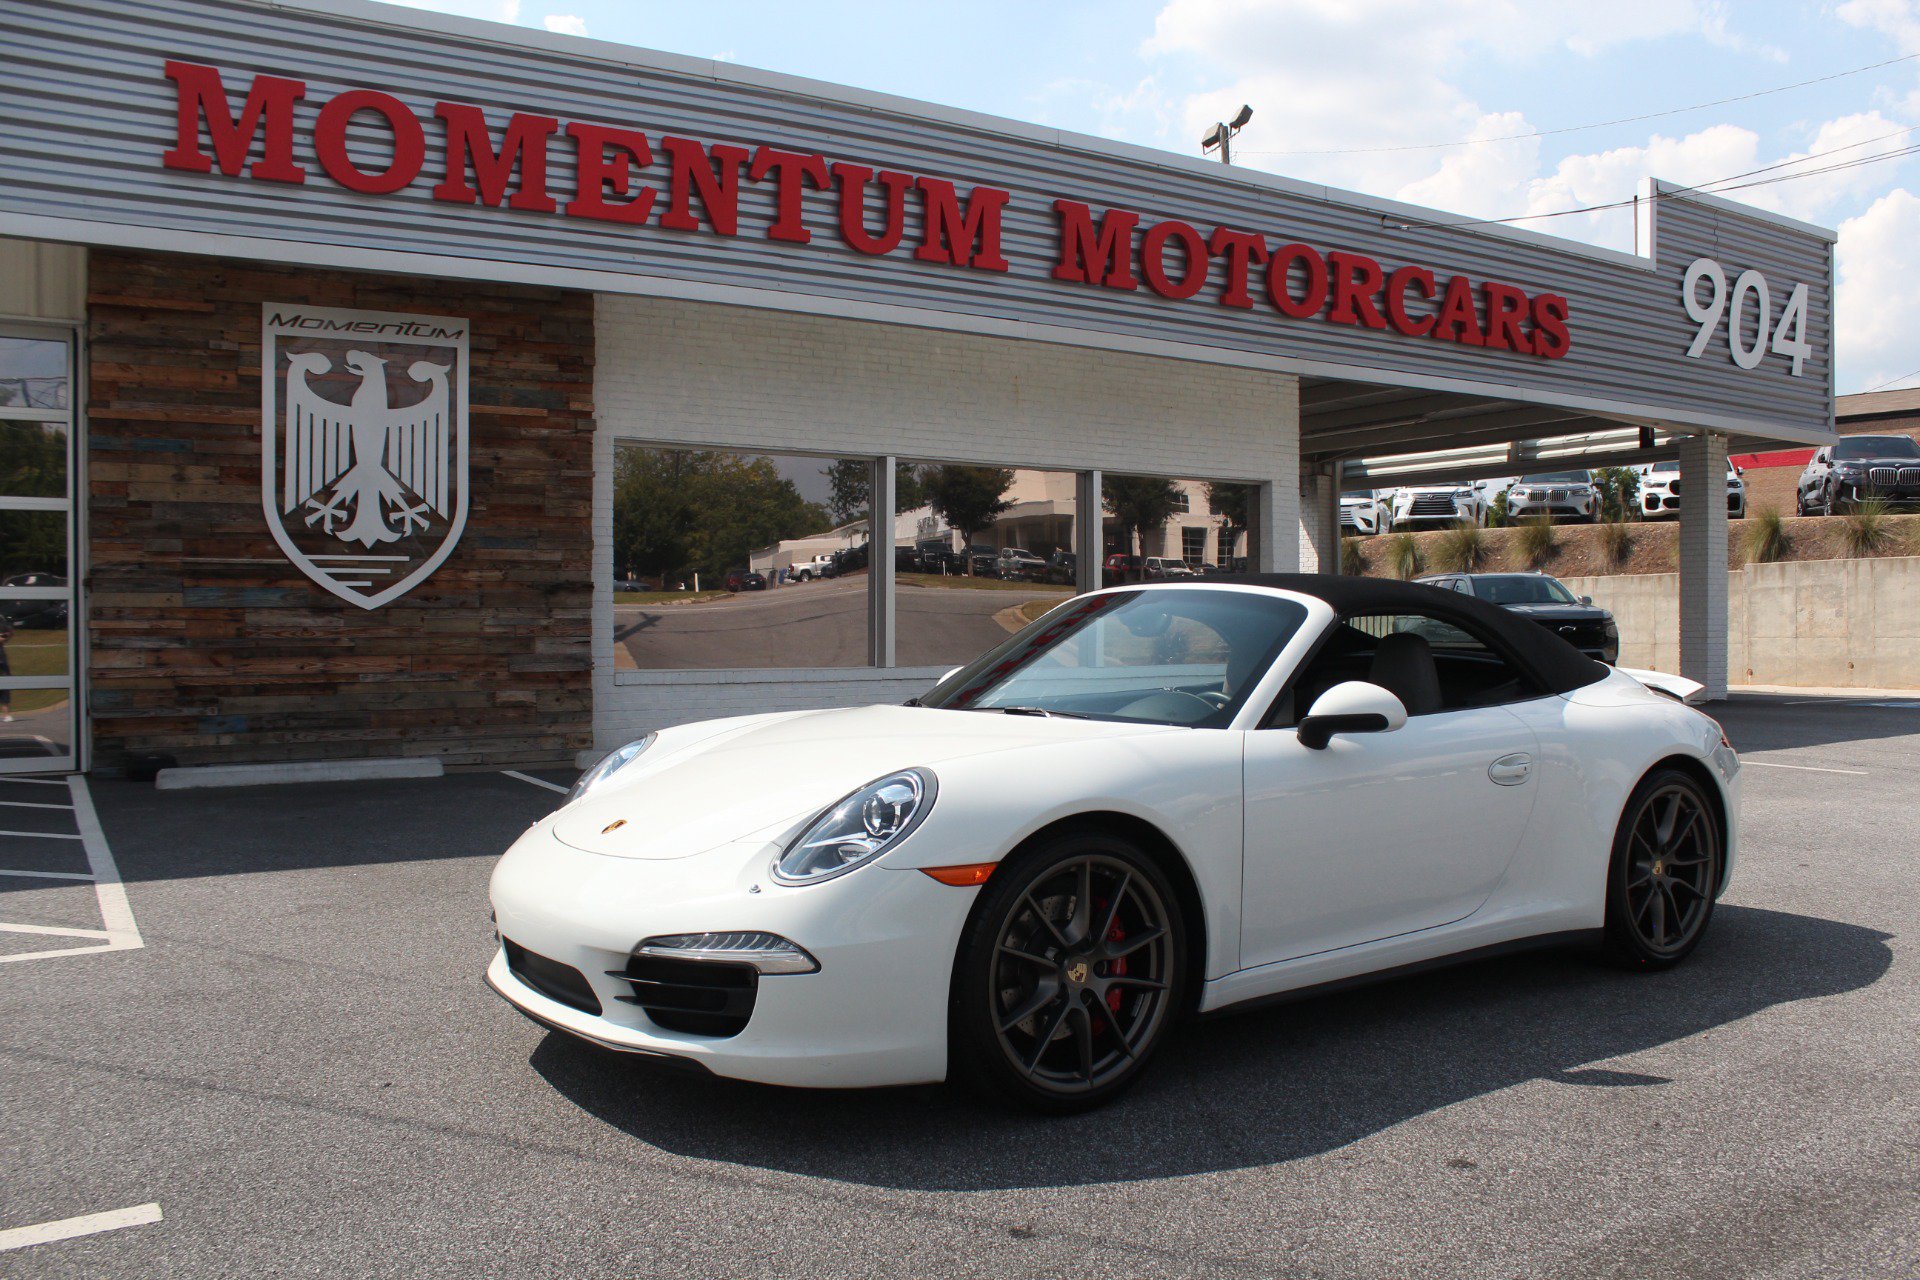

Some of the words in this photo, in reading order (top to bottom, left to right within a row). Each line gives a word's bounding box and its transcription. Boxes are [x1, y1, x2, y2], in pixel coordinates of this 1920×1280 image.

[164, 59, 1010, 272] MOMENTUM
[1051, 199, 1571, 360] MOTORCARS
[1683, 257, 1812, 377] 904
